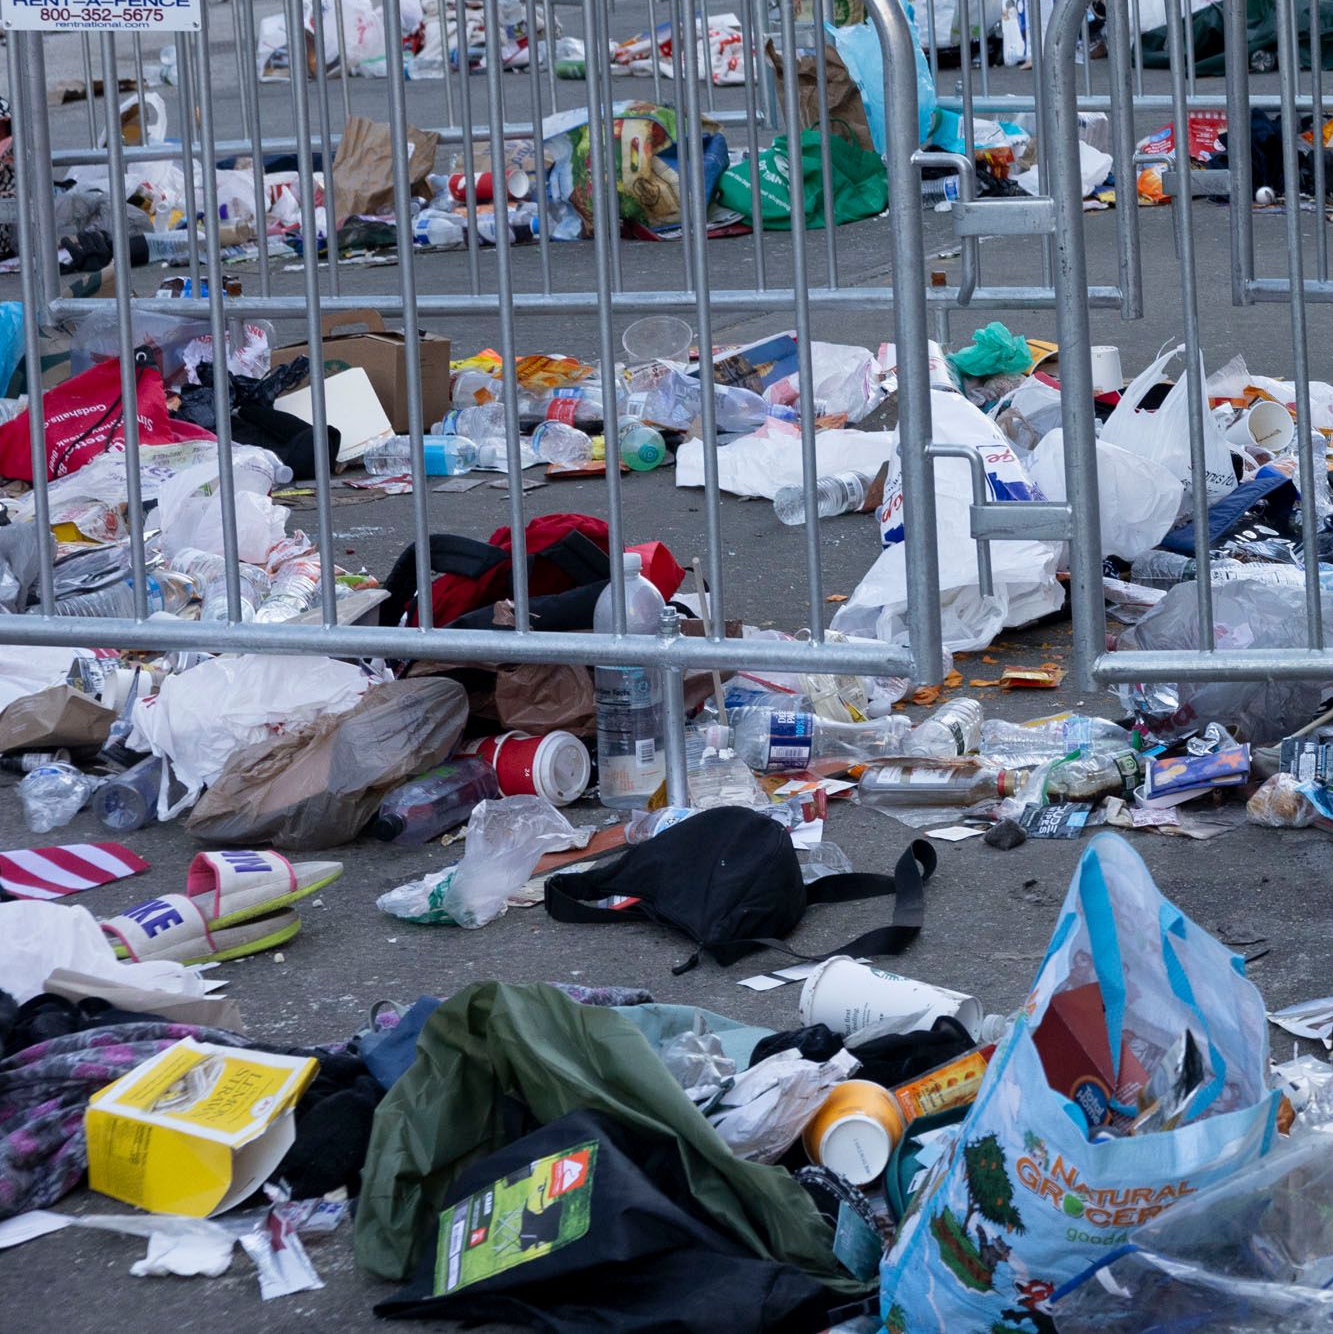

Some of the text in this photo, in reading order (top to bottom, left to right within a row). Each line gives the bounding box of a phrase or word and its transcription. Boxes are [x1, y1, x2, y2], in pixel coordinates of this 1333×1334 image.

[40, 7, 164, 22] 800-352-5675
[55, 21, 150, 30] rentnational.com
[53, 403, 108, 433] Godshalls.c
[1077, 1089, 1102, 1127] Home
[1083, 1083, 1106, 1118] Total
[1015, 1156, 1176, 1228] GROCER
[1049, 1152, 1200, 1207] NATURAL
